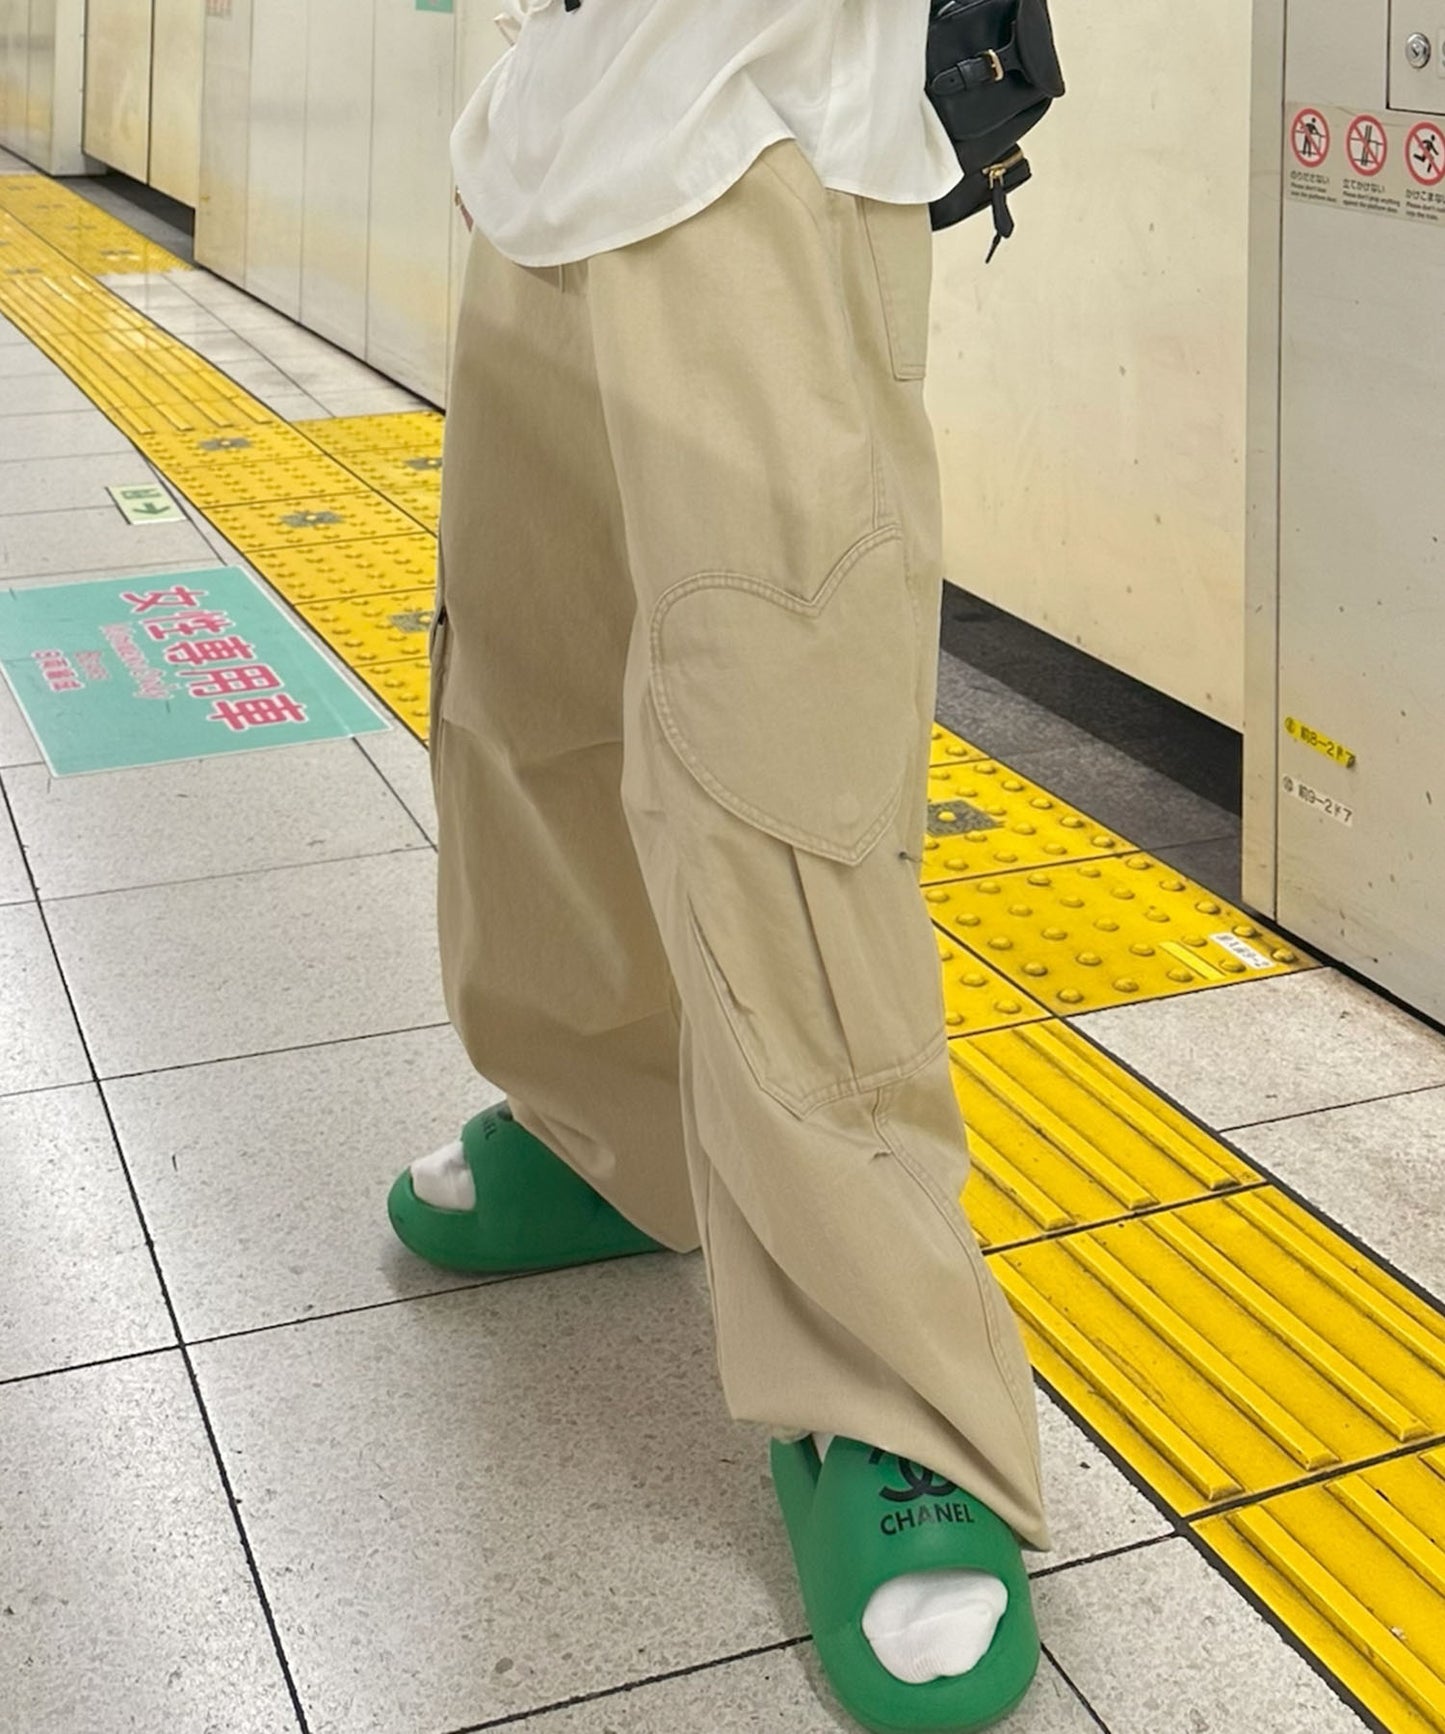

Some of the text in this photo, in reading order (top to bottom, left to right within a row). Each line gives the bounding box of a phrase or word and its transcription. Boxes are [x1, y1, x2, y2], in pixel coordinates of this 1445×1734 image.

[120, 585, 309, 732] 女性専用車
[880, 1502, 975, 1535] CHANEL
